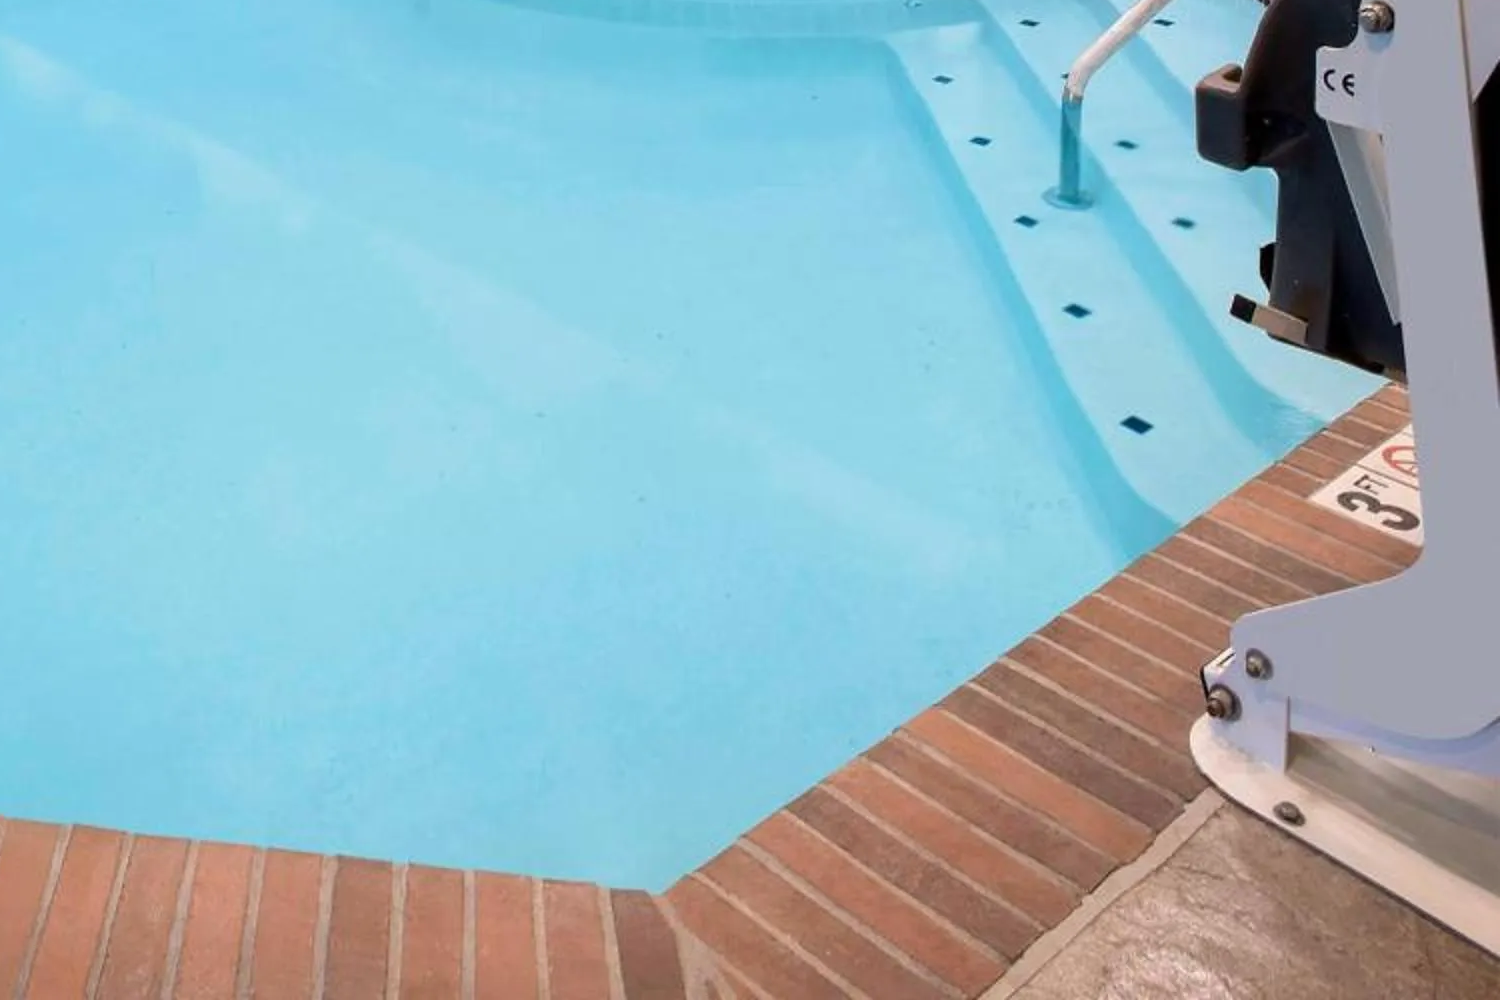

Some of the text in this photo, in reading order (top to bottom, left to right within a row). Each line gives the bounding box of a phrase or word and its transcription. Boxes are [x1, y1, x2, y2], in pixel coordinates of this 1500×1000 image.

[1323, 68, 1355, 97] CE
[1337, 474, 1421, 531] 3 FT
